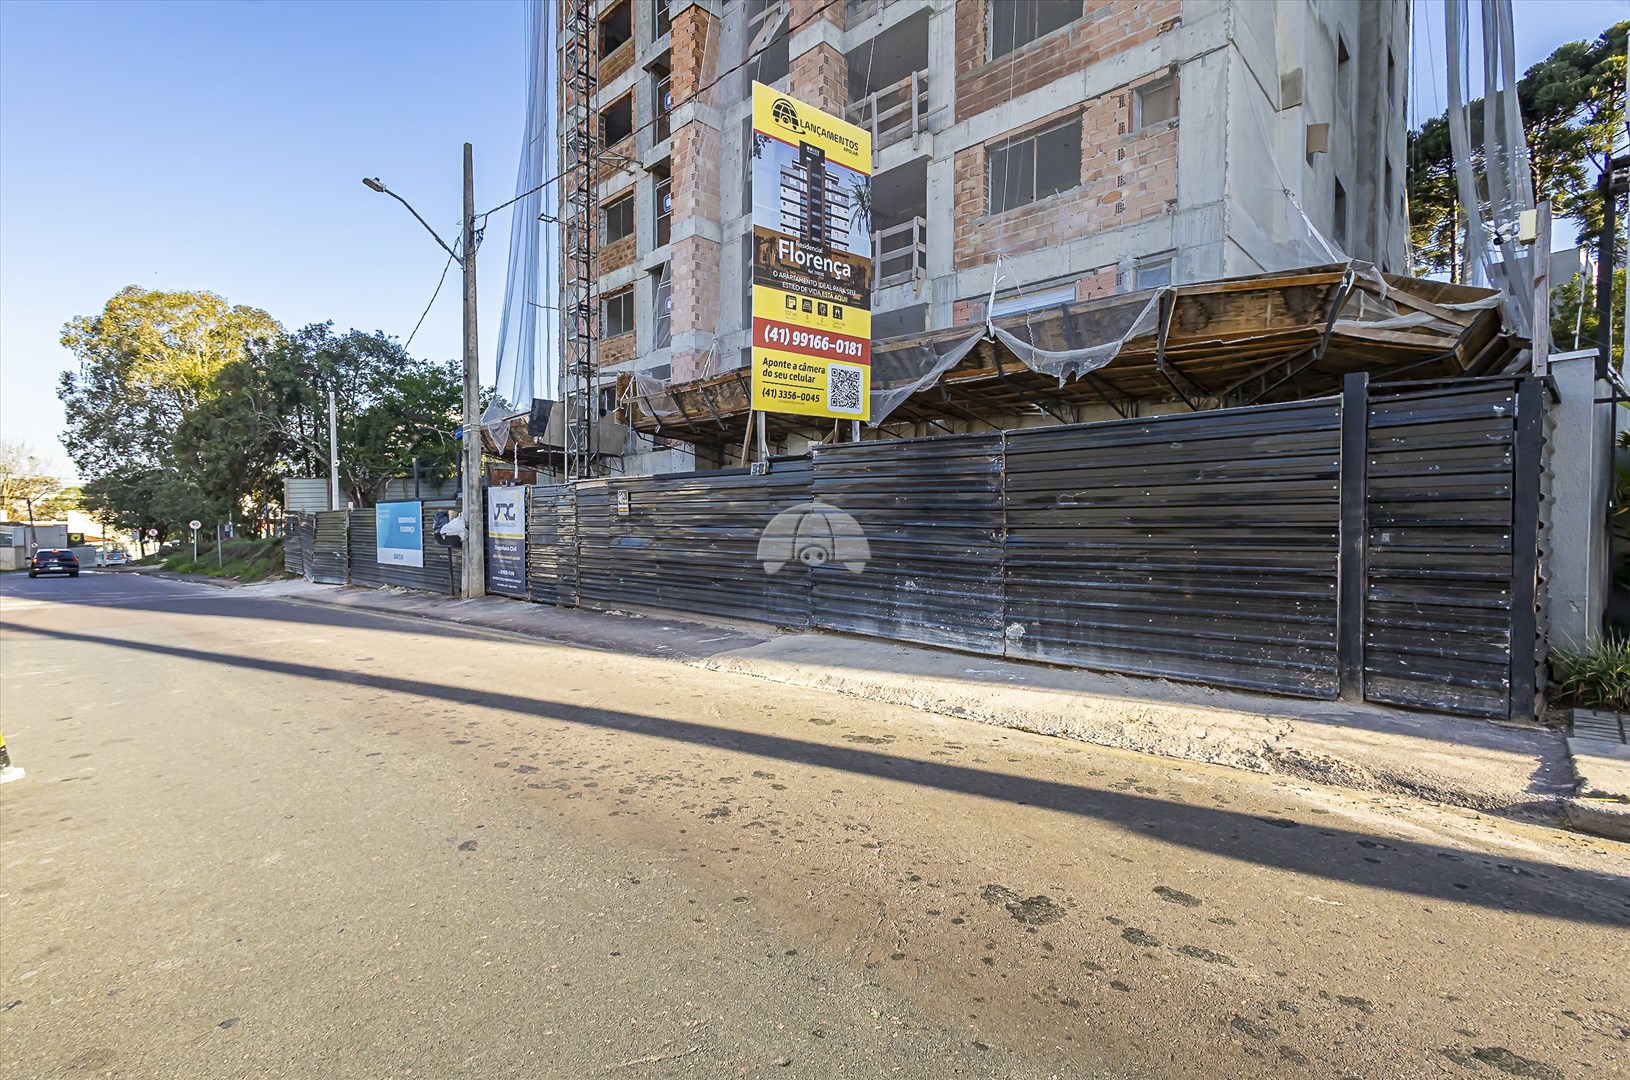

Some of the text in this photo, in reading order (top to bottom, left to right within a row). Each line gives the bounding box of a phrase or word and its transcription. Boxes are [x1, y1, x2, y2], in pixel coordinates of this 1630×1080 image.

[800, 119, 859, 151] LANÇAMENTOS
[795, 240, 823, 254] Residencial
[779, 239, 851, 280] Florença
[779, 272, 818, 287] APARTAMENTO
[818, 281, 833, 291] IDEAL
[833, 285, 846, 295] PARA
[782, 281, 801, 292] ESTILO
[801, 285, 808, 293] DE
[808, 287, 821, 297] VIDA
[764, 324, 862, 357] (41) 99166-0181
[762, 357, 791, 369] Aponte
[798, 362, 825, 375] câmera
[762, 368, 815, 383] do seu celular
[762, 387, 777, 399] (41)
[778, 389, 820, 403] 3356-0045
